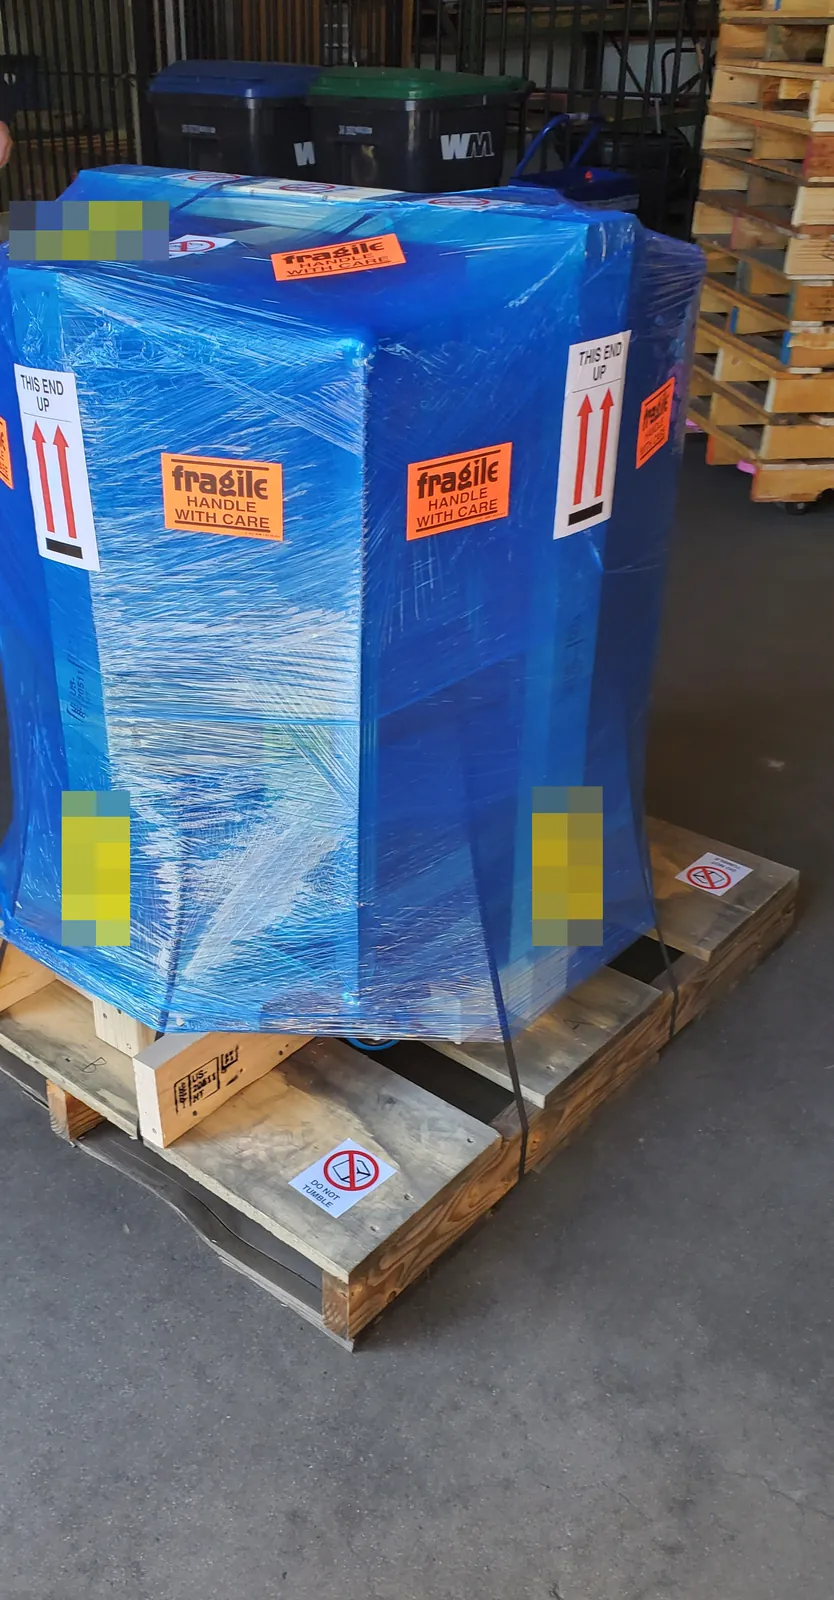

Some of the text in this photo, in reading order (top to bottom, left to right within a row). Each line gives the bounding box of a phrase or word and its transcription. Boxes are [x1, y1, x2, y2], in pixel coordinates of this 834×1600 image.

[440, 131, 495, 160] WM
[283, 242, 385, 265] fragile
[299, 252, 374, 269] HANDLE
[286, 255, 390, 276] WITH CARE
[579, 341, 622, 367] THIS END
[592, 364, 607, 381] UP
[20, 374, 64, 396] THIS END
[36, 396, 50, 413] UP
[171, 464, 269, 500] fragile
[416, 456, 500, 499] fragile
[186, 495, 257, 514] HANDLE
[428, 486, 488, 511] HANDLE
[174, 508, 270, 530] WITH CARE
[416, 509, 453, 528] WITH
[457, 498, 498, 518] CARE
[302, 1183, 335, 1208] TUMBLE
[310, 1179, 341, 1201] DO NOT
